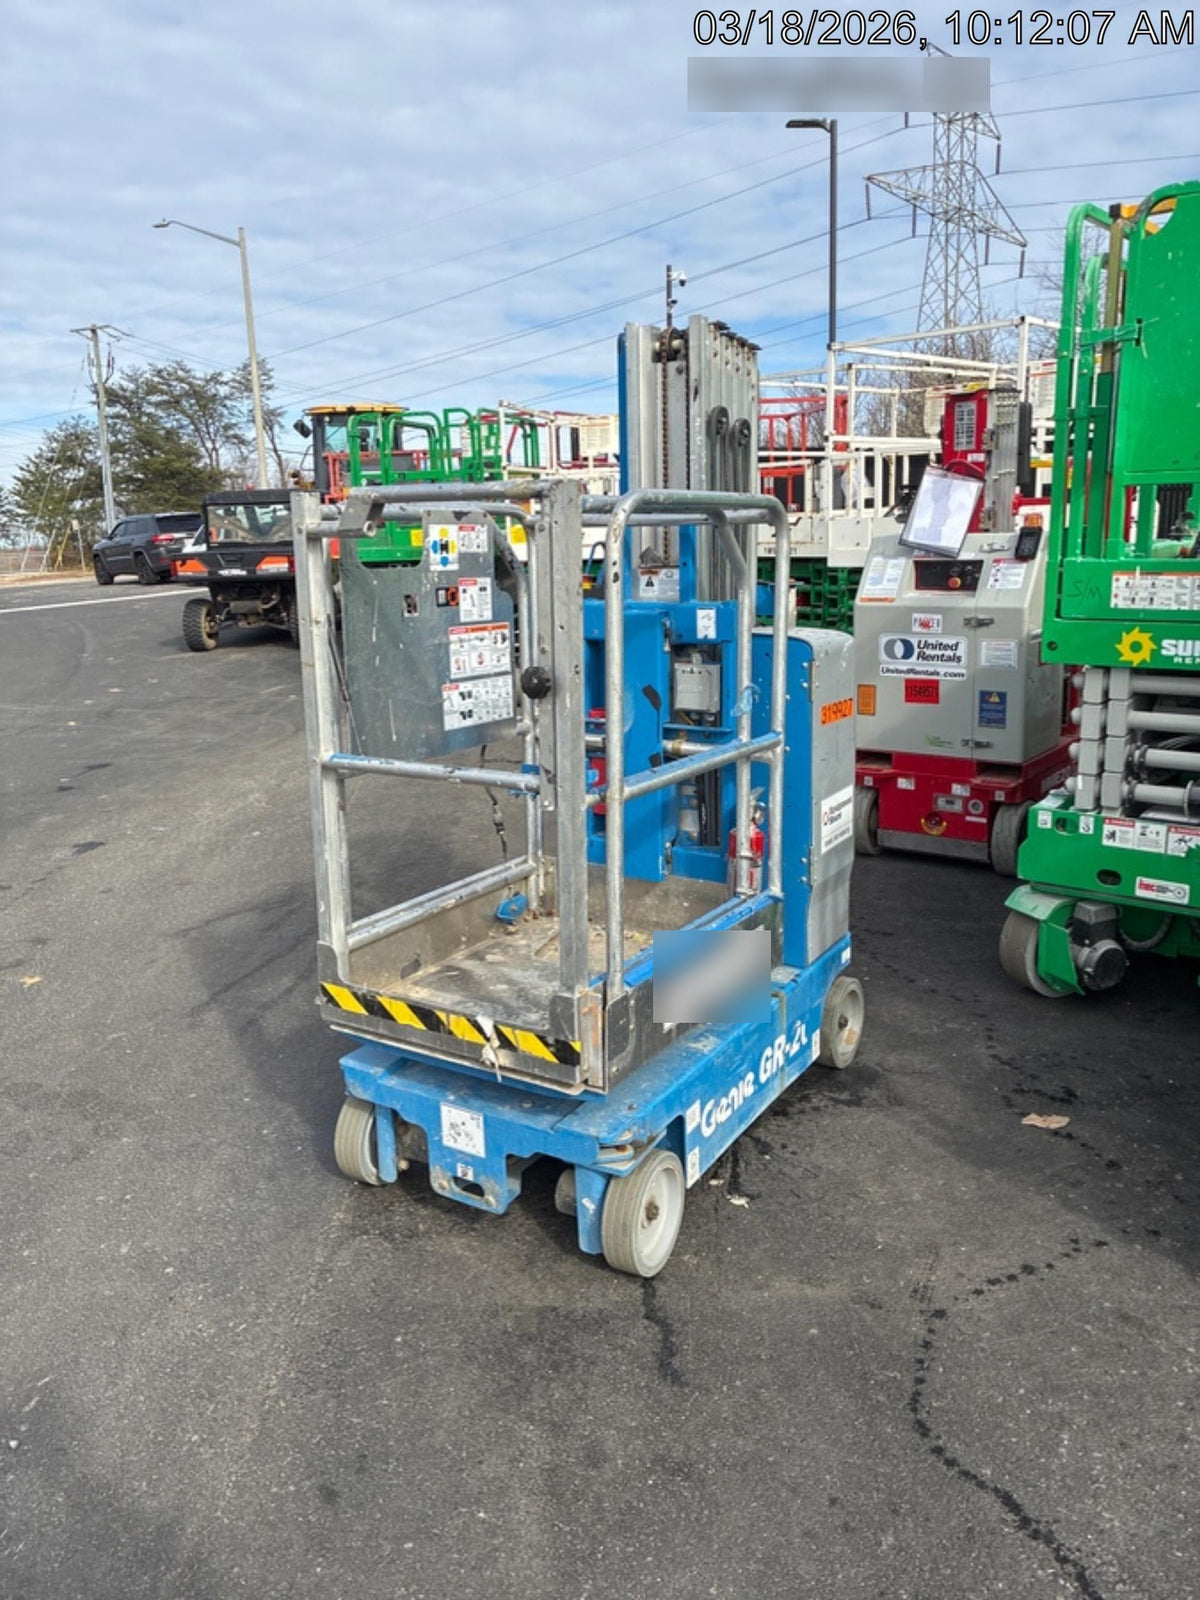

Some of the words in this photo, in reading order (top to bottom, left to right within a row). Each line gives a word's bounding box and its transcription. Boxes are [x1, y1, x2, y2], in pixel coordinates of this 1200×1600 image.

[917, 639, 960, 652] United
[917, 650, 963, 663] Rentals
[821, 698, 853, 724] 319927
[701, 1071, 755, 1138] Genie
